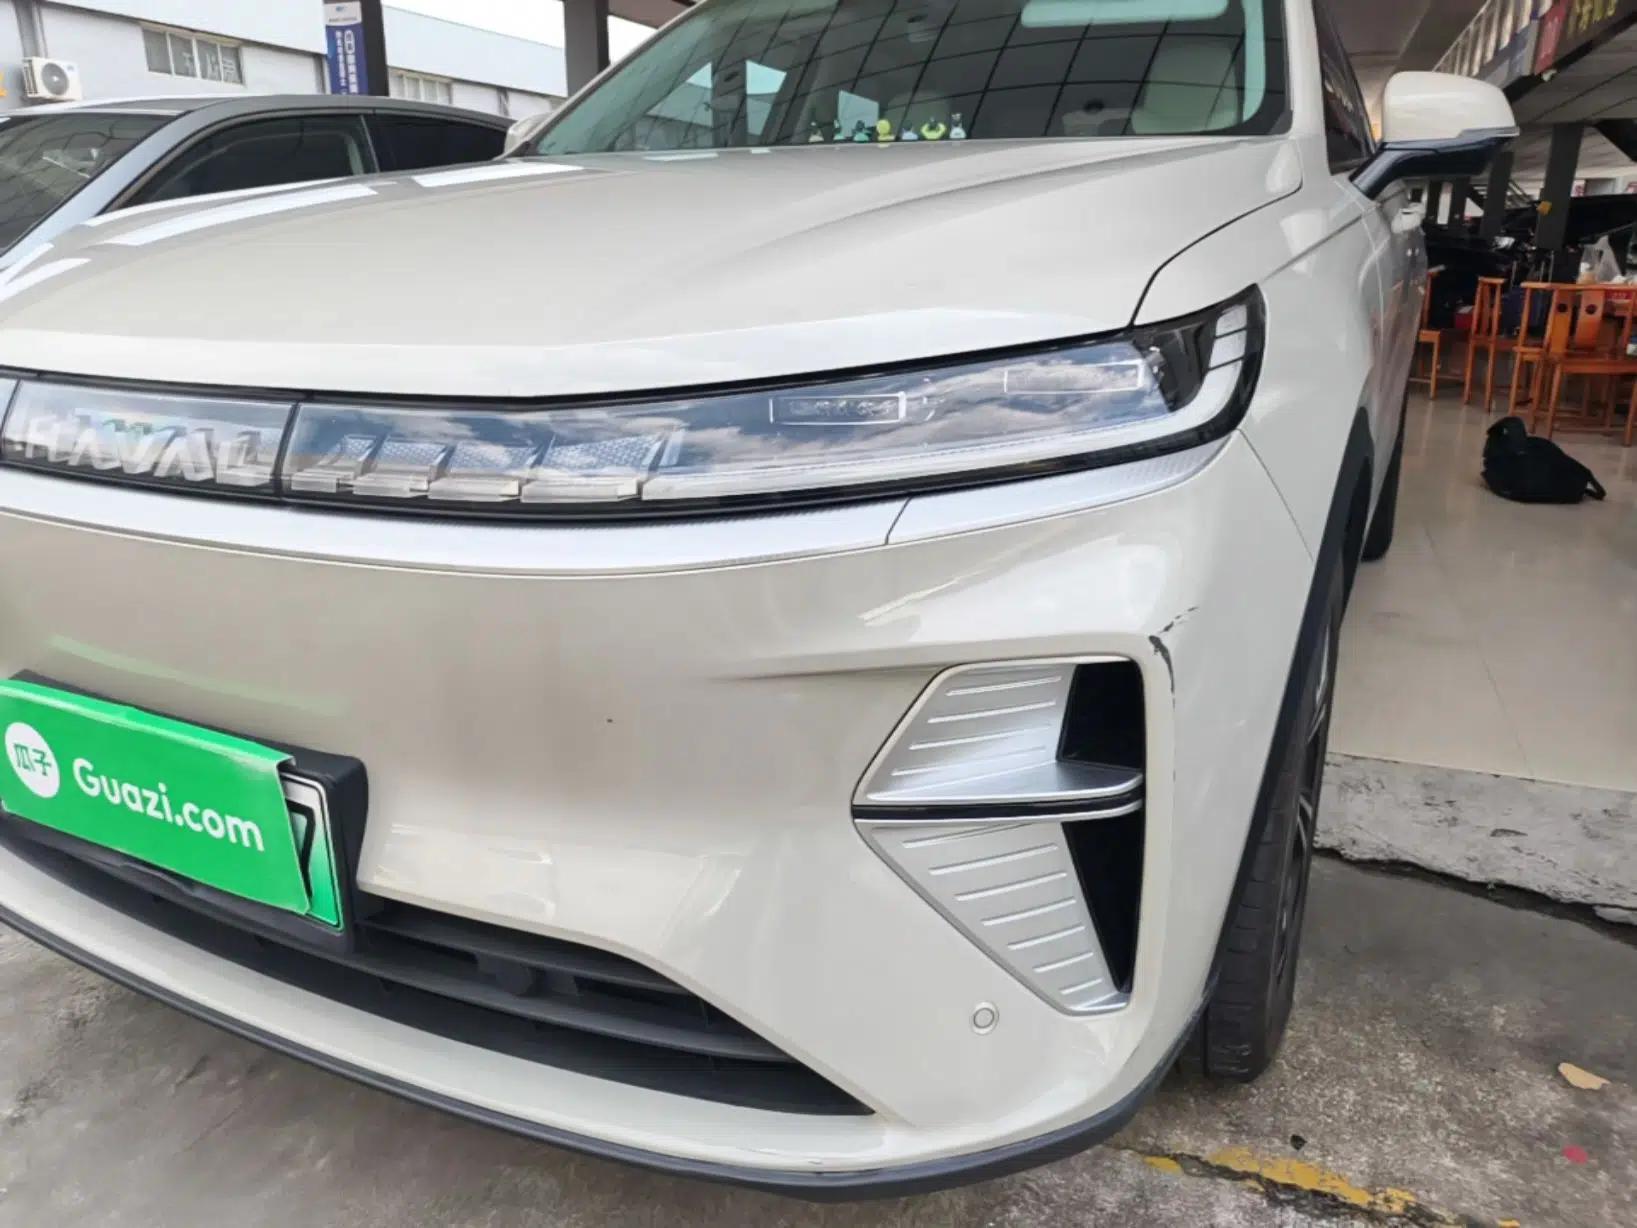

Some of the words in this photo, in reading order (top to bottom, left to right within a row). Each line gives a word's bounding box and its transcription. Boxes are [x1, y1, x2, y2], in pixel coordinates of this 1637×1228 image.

[24, 412, 272, 487] HAVAL
[13, 743, 52, 777] 瓜子
[72, 757, 265, 852] Guazi.com
